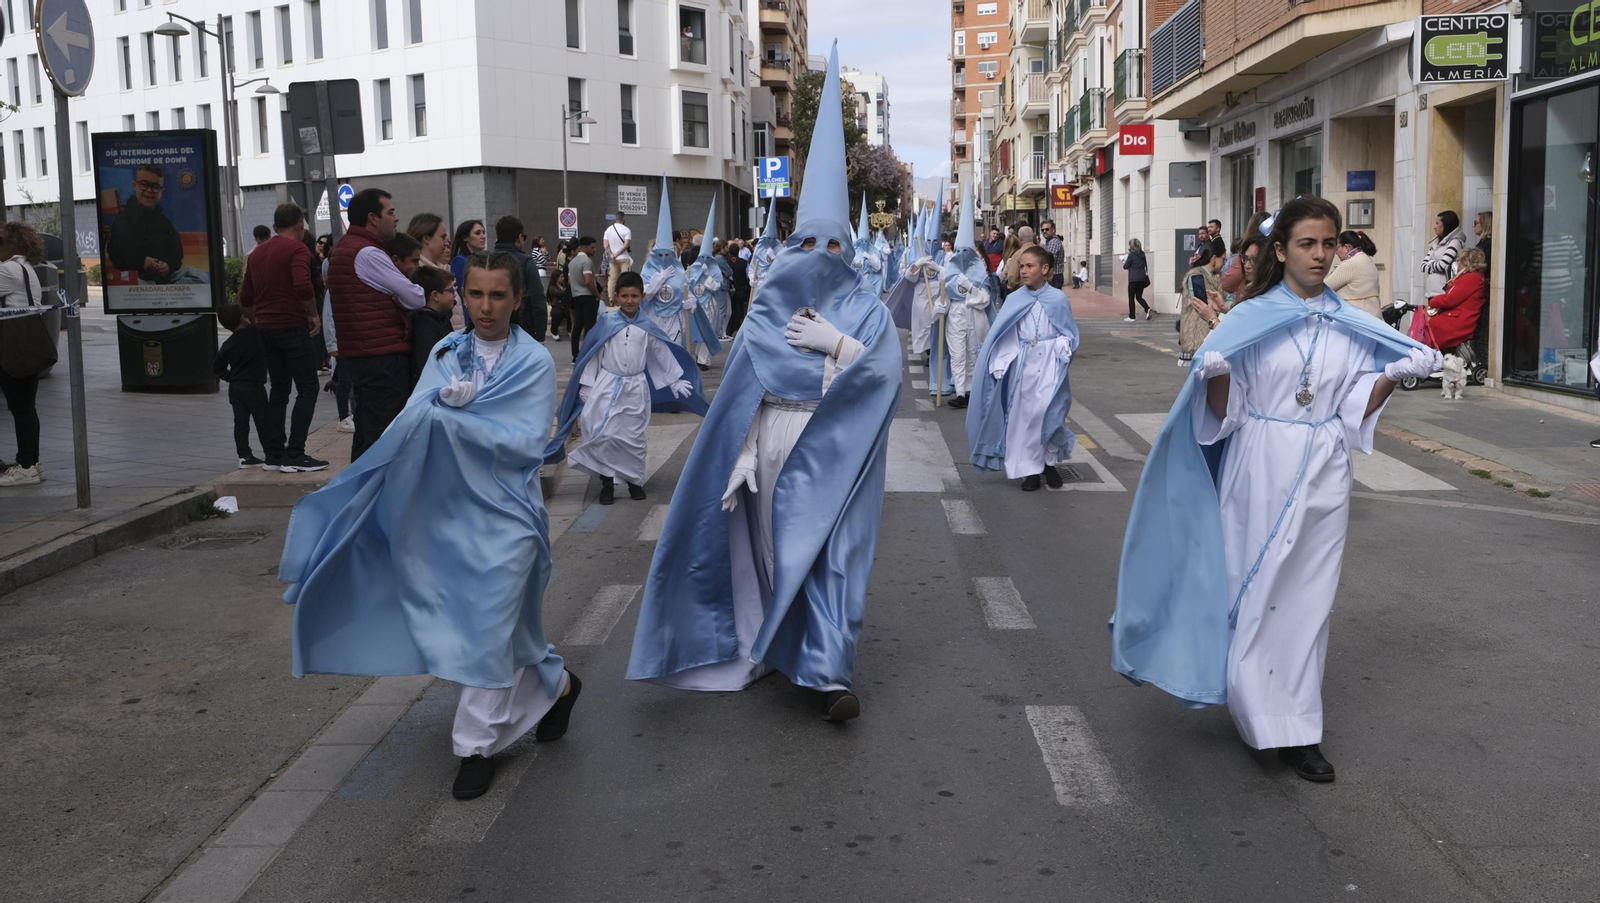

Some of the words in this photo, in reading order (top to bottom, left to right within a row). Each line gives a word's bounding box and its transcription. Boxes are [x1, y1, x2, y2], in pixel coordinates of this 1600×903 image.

[1425, 16, 1505, 31] CENTRO
[1423, 68, 1505, 81] ALMERÍA
[105, 148, 118, 157] DÍA
[120, 147, 178, 156] INTERNACIONAL
[113, 157, 151, 166] SÍNDROME
[165, 156, 187, 164] DOWN
[766, 157, 781, 178] P
